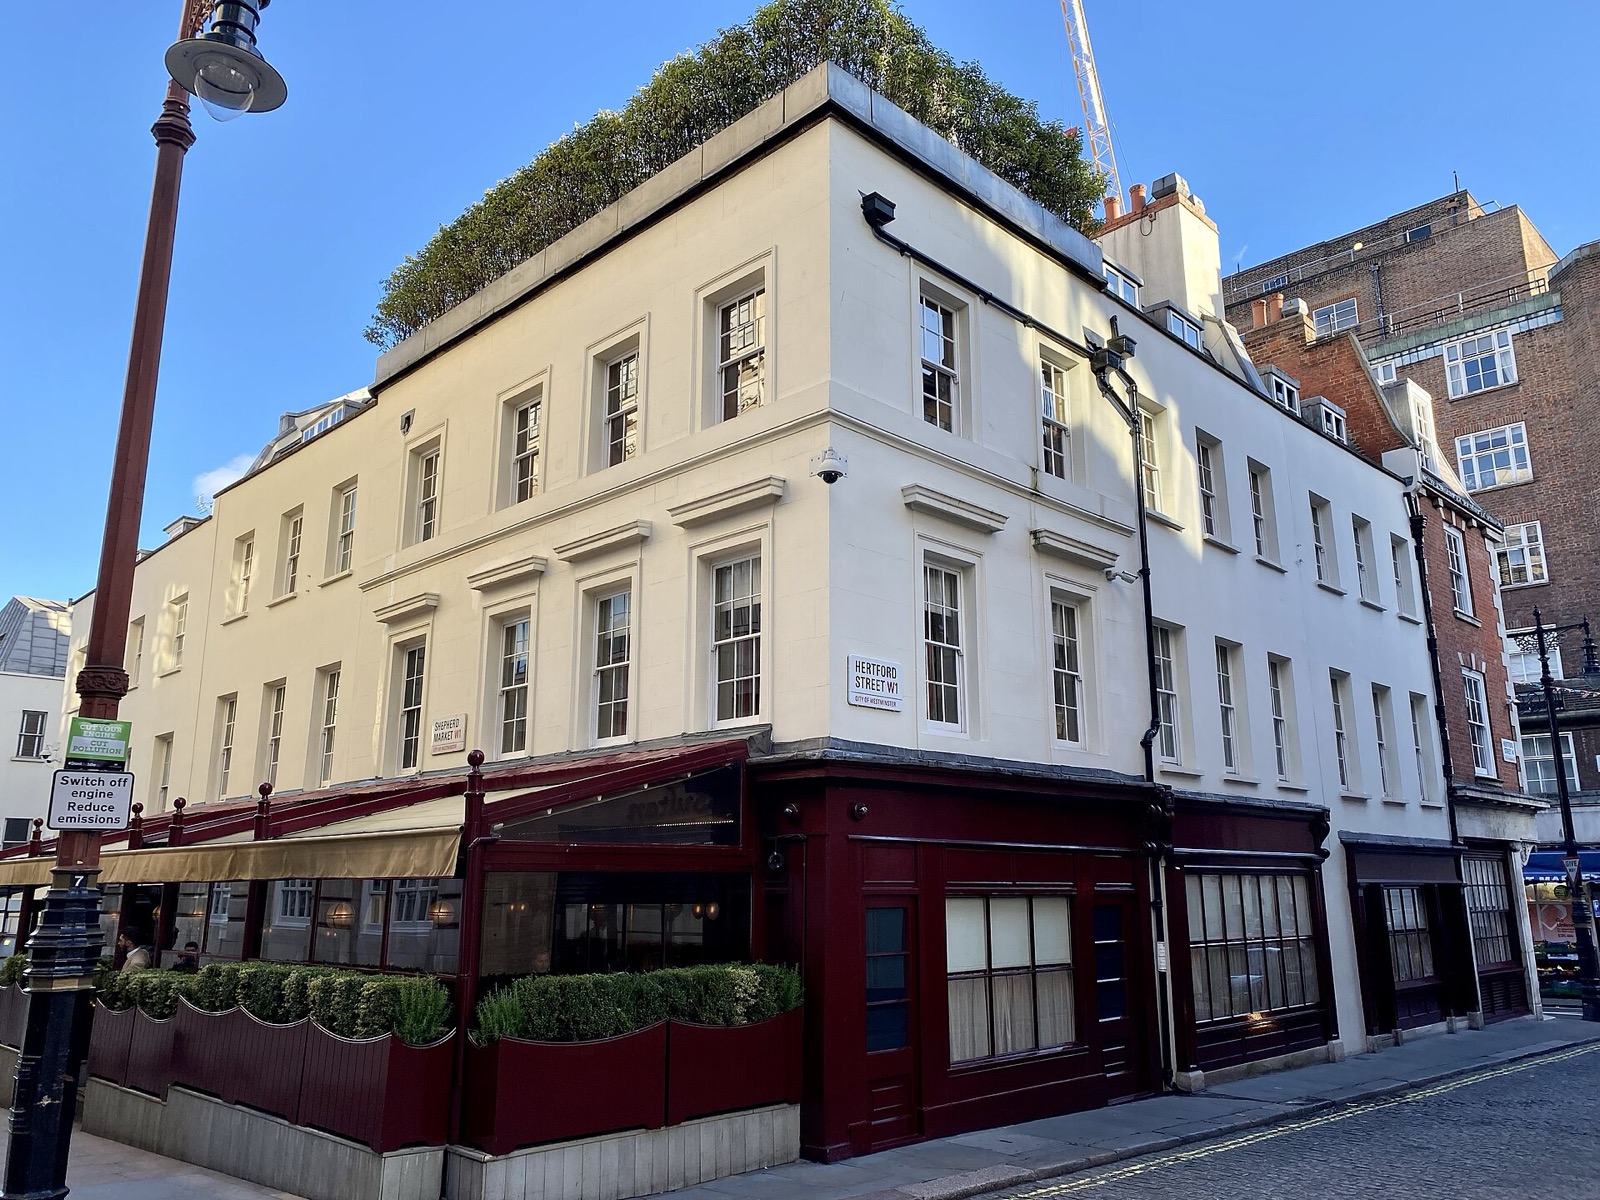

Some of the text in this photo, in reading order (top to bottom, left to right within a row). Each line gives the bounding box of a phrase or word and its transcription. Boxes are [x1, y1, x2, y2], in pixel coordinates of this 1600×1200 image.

[855, 660, 897, 679] HERTFORD
[855, 676, 898, 694] STREET W1
[98, 724, 122, 733] YOUR
[434, 718, 460, 731] SHEPHERD
[434, 731, 453, 742] MARKET
[72, 745, 122, 754] POLLUTION
[60, 775, 128, 787] Switch off
[71, 788, 114, 800] engine
[67, 802, 115, 812] Reduce
[57, 814, 121, 824] emissions
[74, 876, 84, 887] 7
